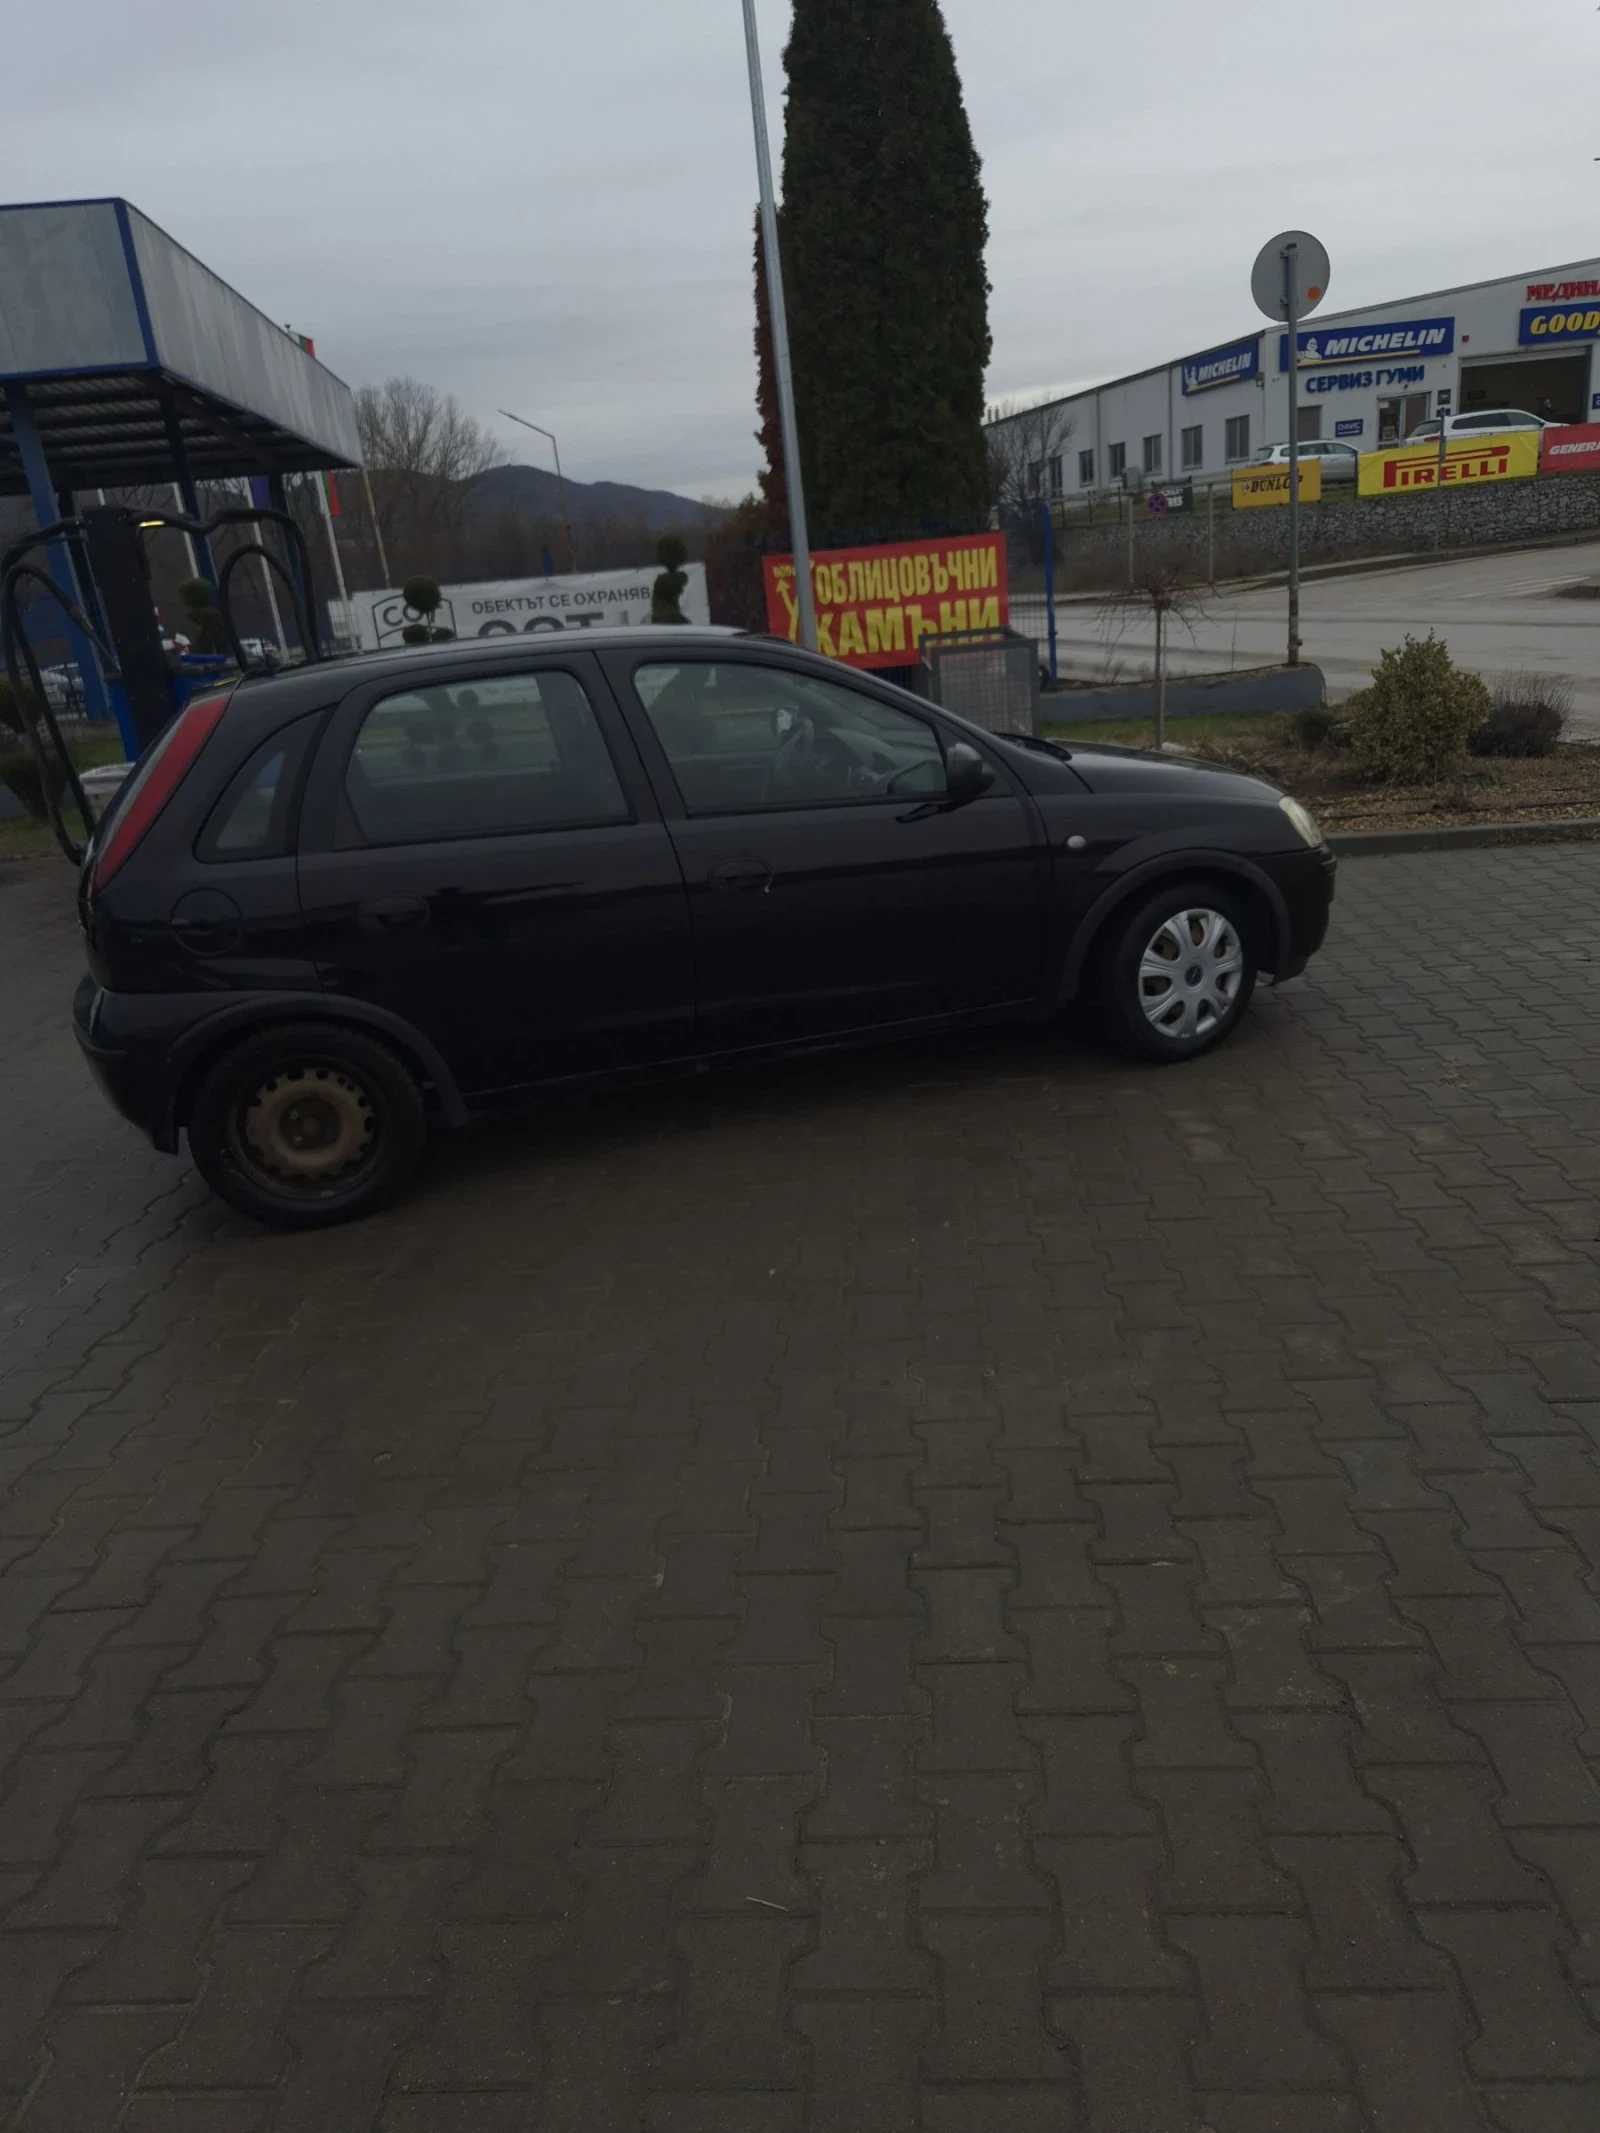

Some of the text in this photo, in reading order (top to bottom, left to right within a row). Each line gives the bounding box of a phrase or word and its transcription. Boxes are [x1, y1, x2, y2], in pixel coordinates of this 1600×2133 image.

[1526, 279, 1600, 302] МЕДИН
[1530, 310, 1600, 335] GOOD
[1324, 327, 1446, 356] MICHELIN
[1199, 352, 1252, 382] MICHELIN
[1306, 365, 1425, 393] СЕРВИЗ ГУМИ
[1383, 445, 1510, 488] PIRELLI
[815, 546, 997, 605] ОБЛИЦОВЪЧНИ
[471, 595, 544, 615] ОБЕКТЪТ
[549, 594, 570, 609] СЕ
[815, 596, 1000, 657] КАМЪНИ
